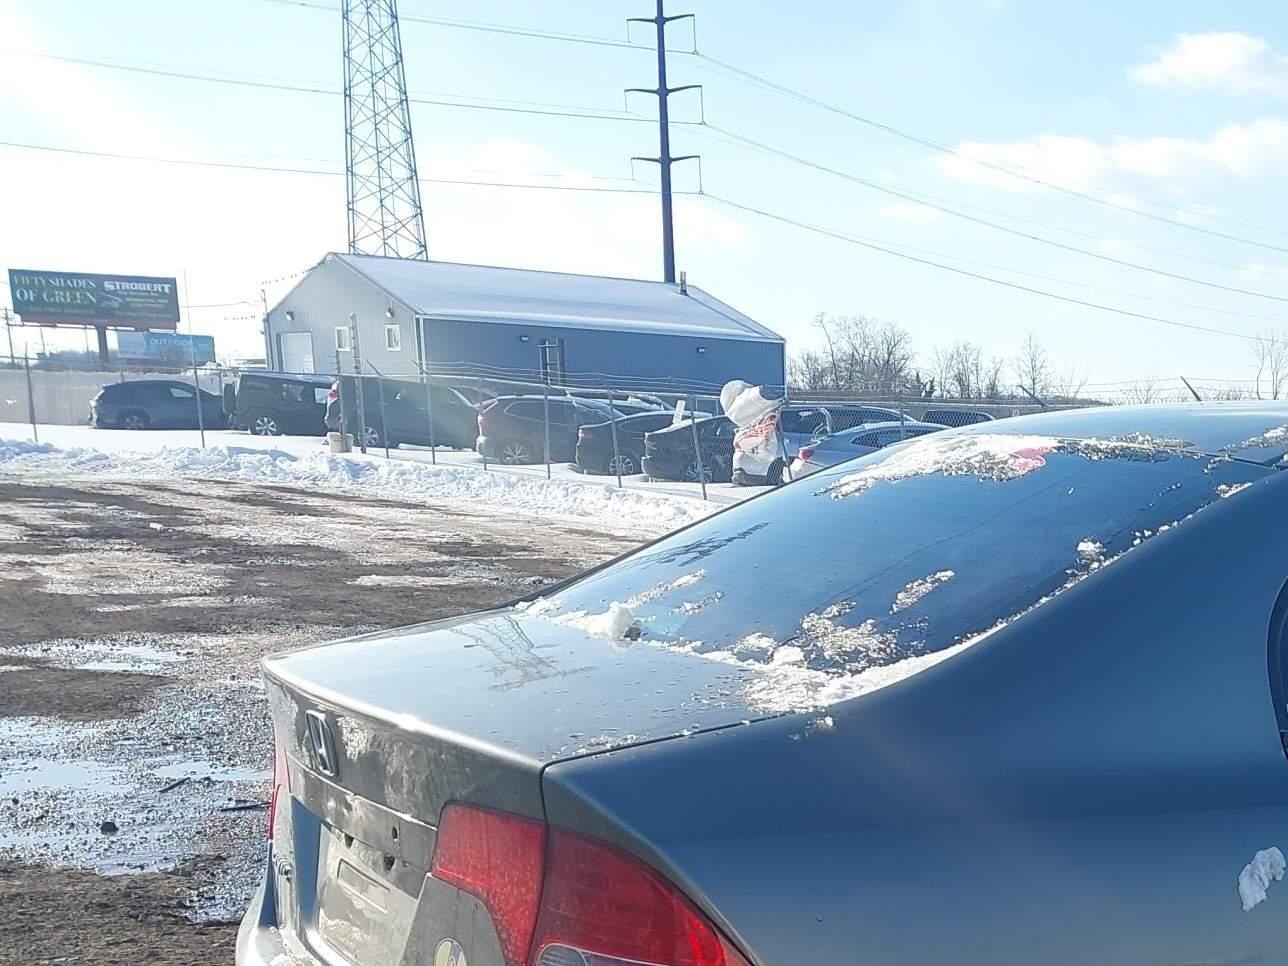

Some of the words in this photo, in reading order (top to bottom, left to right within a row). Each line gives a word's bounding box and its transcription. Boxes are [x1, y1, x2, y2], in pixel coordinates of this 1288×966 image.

[14, 275, 47, 286] FIFTY
[48, 277, 96, 289] SHADES
[104, 281, 172, 294] STROBERT
[15, 287, 39, 302] OF
[42, 289, 97, 304] GREEN
